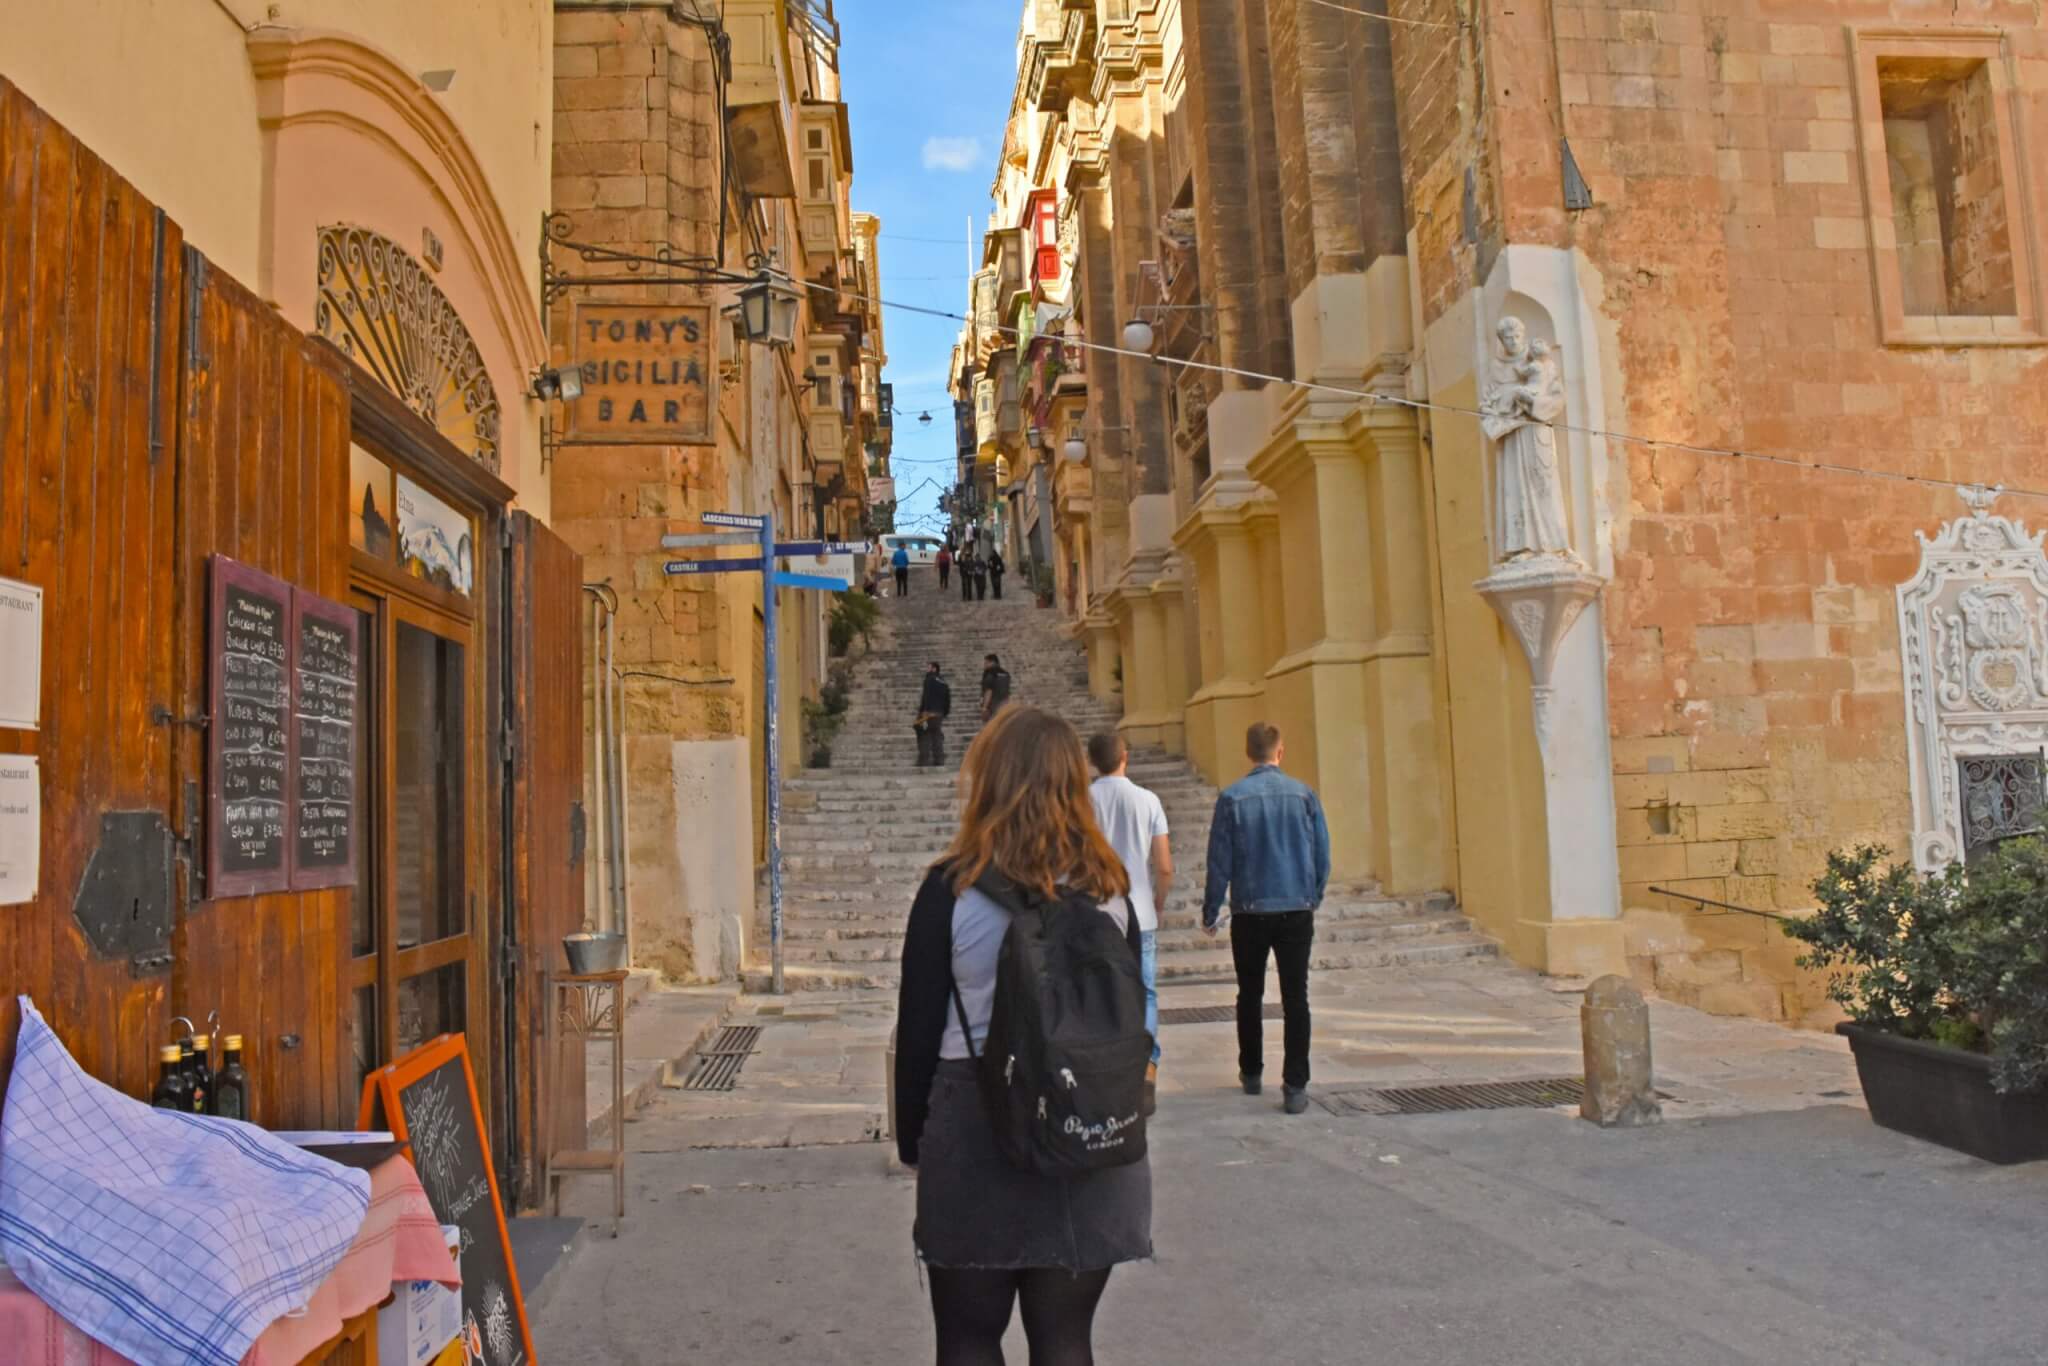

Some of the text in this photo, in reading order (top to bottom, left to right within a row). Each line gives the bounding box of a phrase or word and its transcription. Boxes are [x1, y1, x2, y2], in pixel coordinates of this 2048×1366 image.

[586, 316, 699, 343] TONY'S
[582, 360, 701, 384] SICILIA
[598, 399, 680, 422] BAR
[669, 563, 699, 572] CASTILLE
[1086, 1137, 1125, 1150] LONDON
